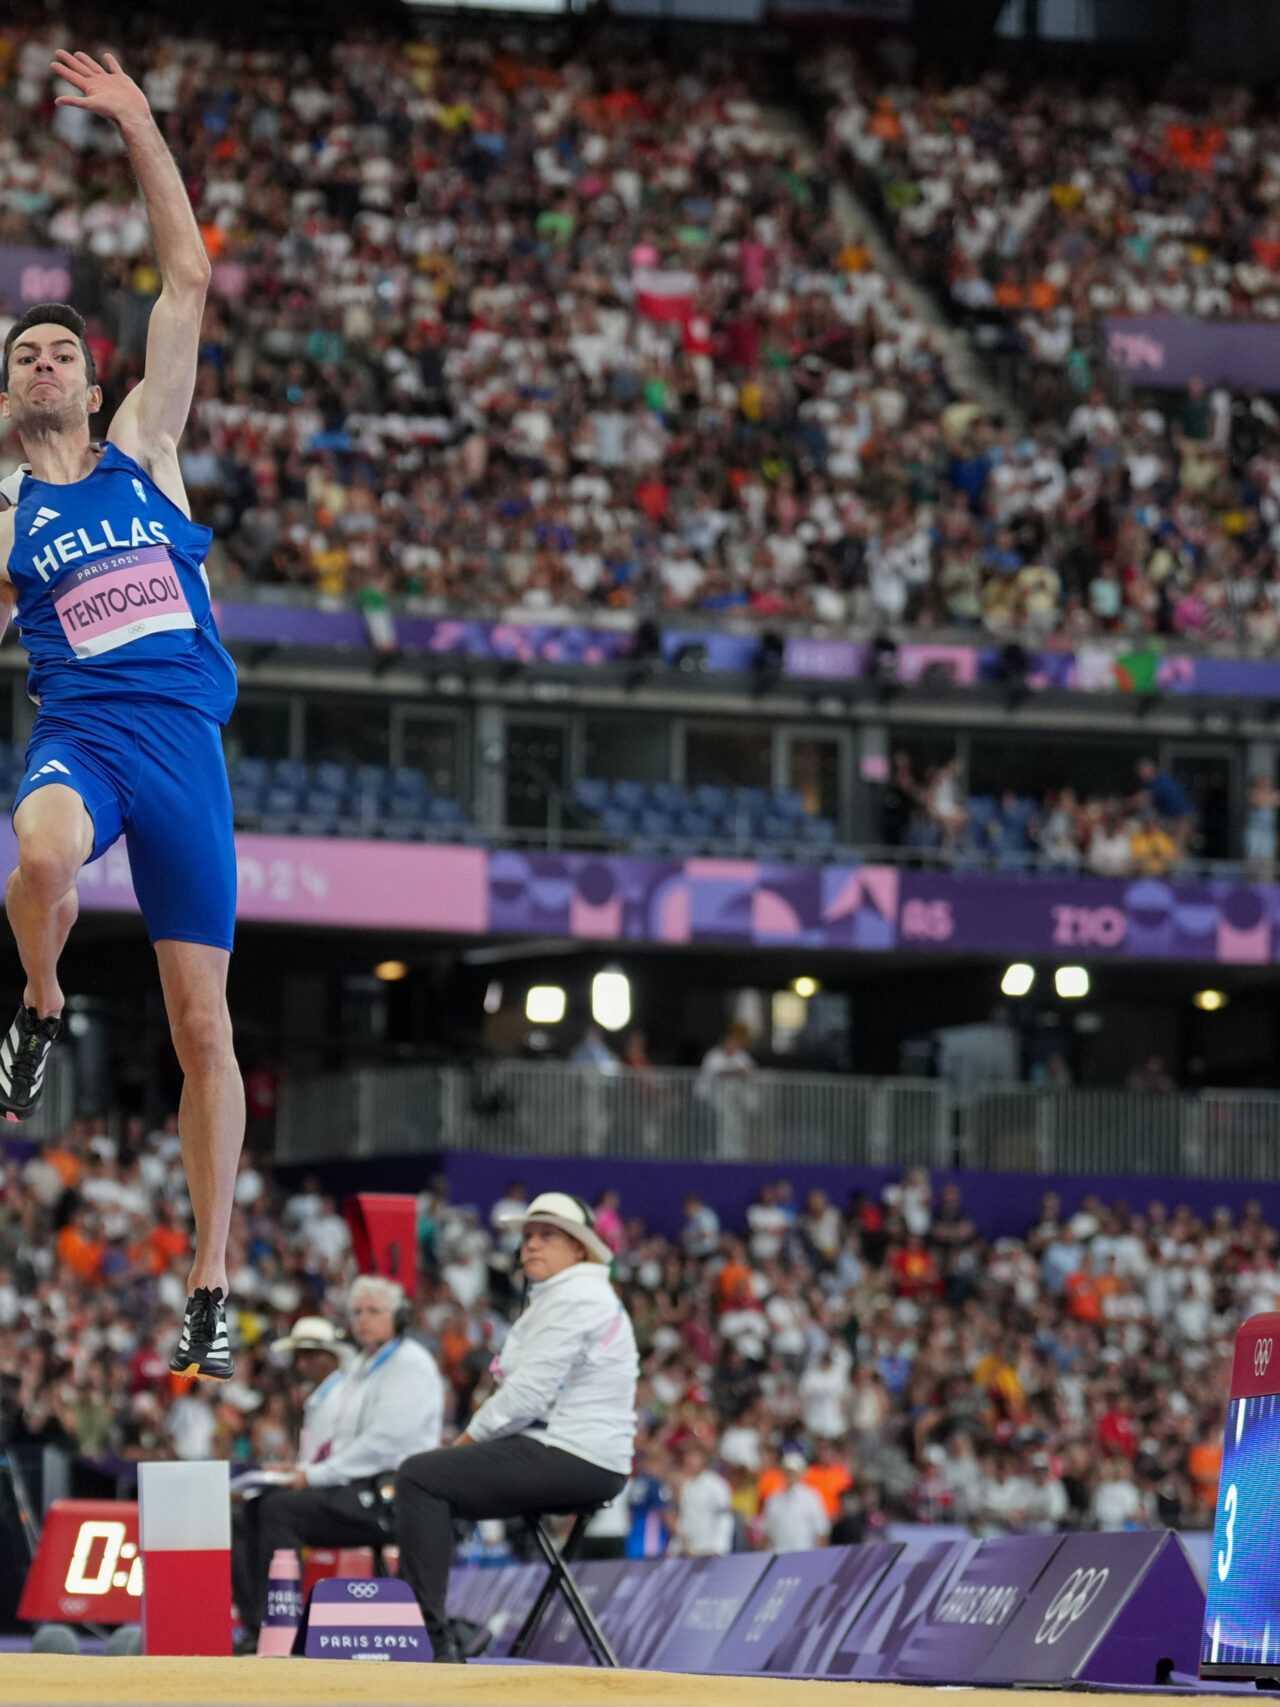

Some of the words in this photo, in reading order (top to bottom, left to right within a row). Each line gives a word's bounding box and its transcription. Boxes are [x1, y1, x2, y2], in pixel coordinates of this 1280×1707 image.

[33, 517, 170, 583] HELLAS
[77, 562, 109, 580] PARIS
[111, 555, 140, 567] 2024
[62, 575, 179, 632] TENTOGLOU
[236, 856, 329, 903] 024
[1218, 1484, 1238, 1582] 3
[319, 1635, 369, 1648] PARIS
[373, 1636, 419, 1649] 2024
